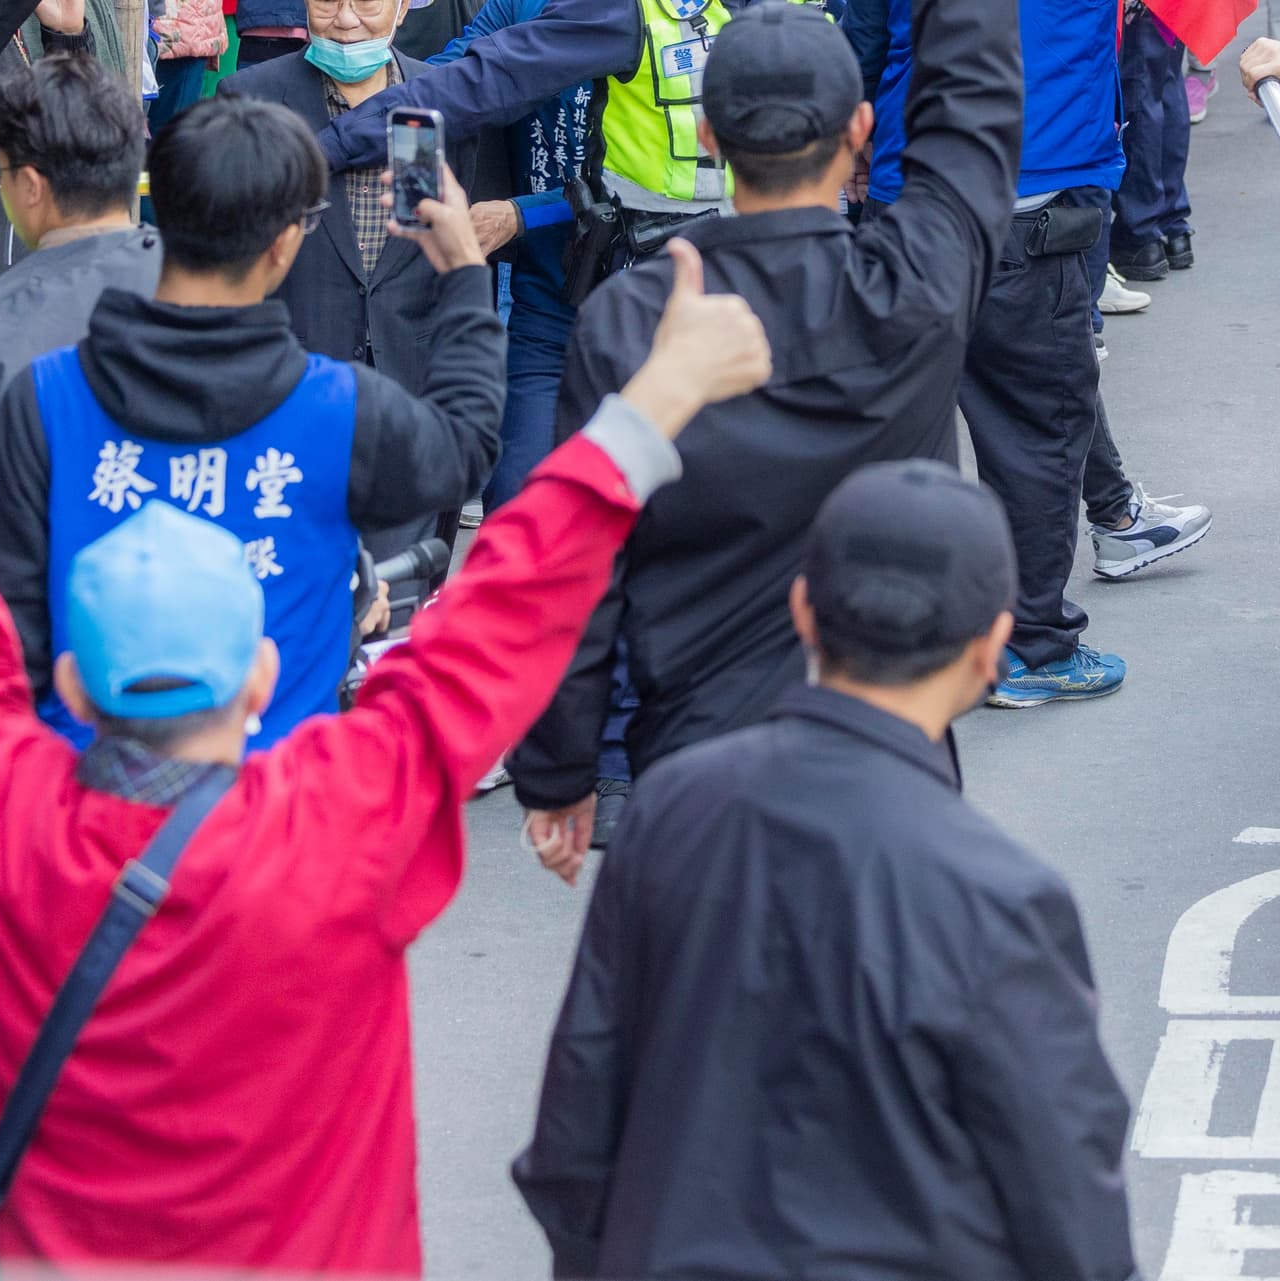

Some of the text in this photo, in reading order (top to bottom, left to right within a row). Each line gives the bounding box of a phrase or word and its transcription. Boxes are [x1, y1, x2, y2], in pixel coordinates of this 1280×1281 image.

[672, 48, 693, 71] 警
[87, 438, 304, 520] 蔡明堂
